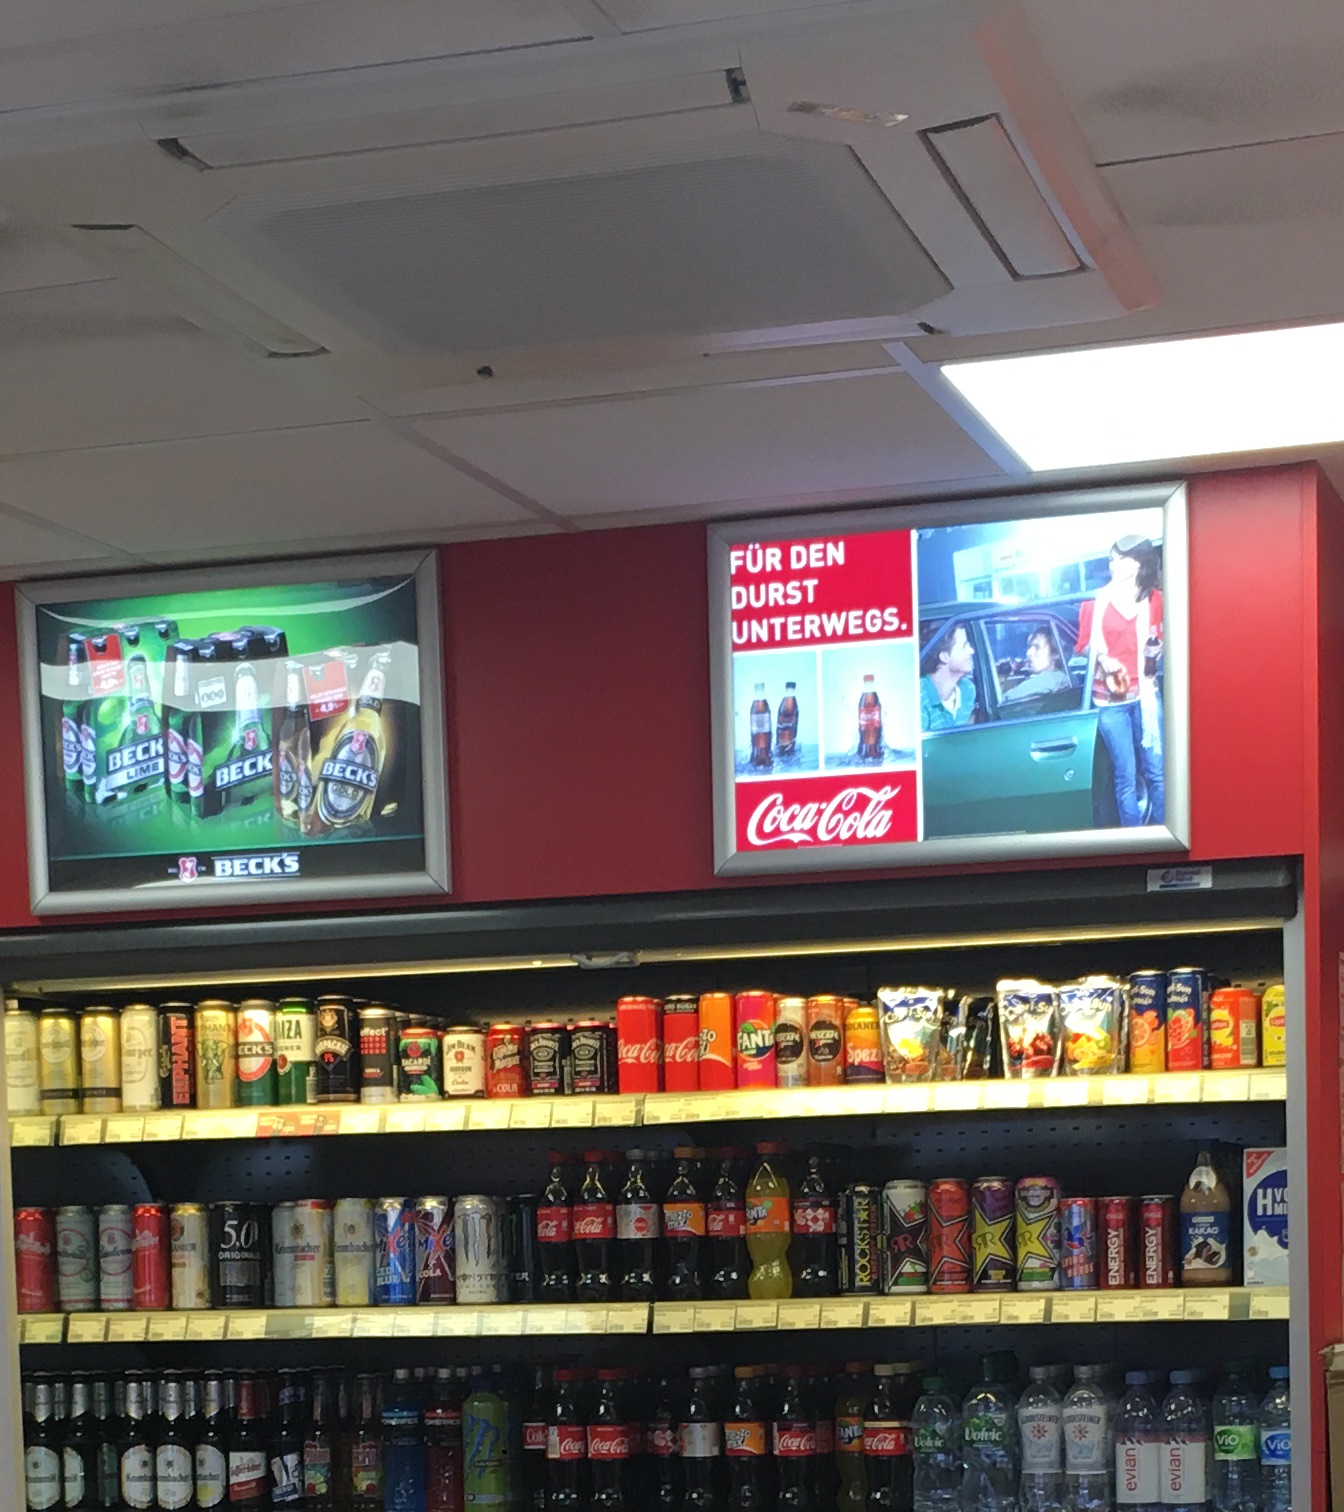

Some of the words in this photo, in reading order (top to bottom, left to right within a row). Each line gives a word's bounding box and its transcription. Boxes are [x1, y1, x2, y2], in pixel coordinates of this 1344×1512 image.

[730, 544, 782, 574] FÜR
[790, 541, 845, 571] DEN
[731, 580, 818, 610] DURST
[731, 608, 908, 645] UNTERWEGS.
[747, 784, 901, 845] Coca-Cola
[214, 853, 300, 877] BECK'S
[1109, 1228, 1119, 1285] ENERGY
[1146, 1227, 1156, 1283] ENERGY
[1126, 1448, 1137, 1492] evian
[1170, 1446, 1181, 1492] evian
